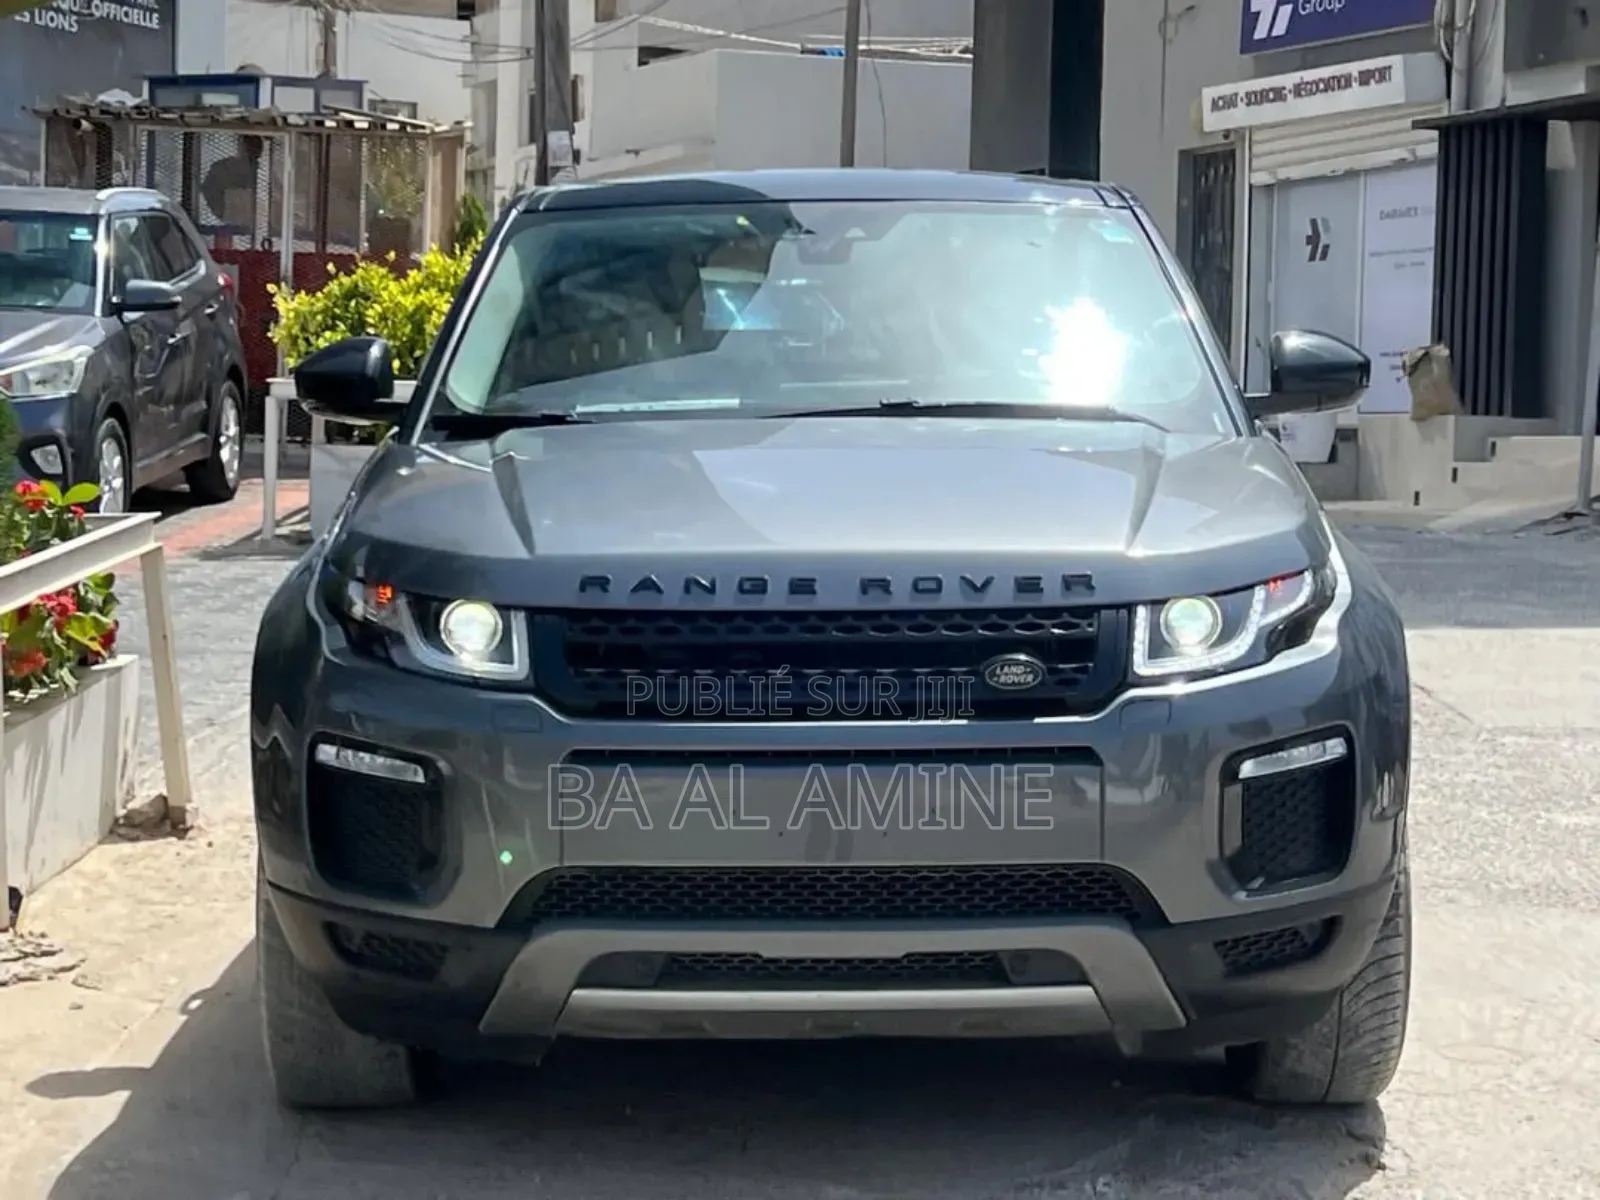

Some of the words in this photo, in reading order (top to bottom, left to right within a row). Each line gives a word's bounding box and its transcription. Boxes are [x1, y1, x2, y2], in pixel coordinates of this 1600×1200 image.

[91, 0, 160, 30] OFFICIELLE
[1298, 0, 1346, 16] Group
[34, 8, 79, 33] LIONS
[1211, 92, 1239, 113] ACHAT
[578, 574, 817, 596] RANGE
[859, 572, 1096, 596] ROVER
